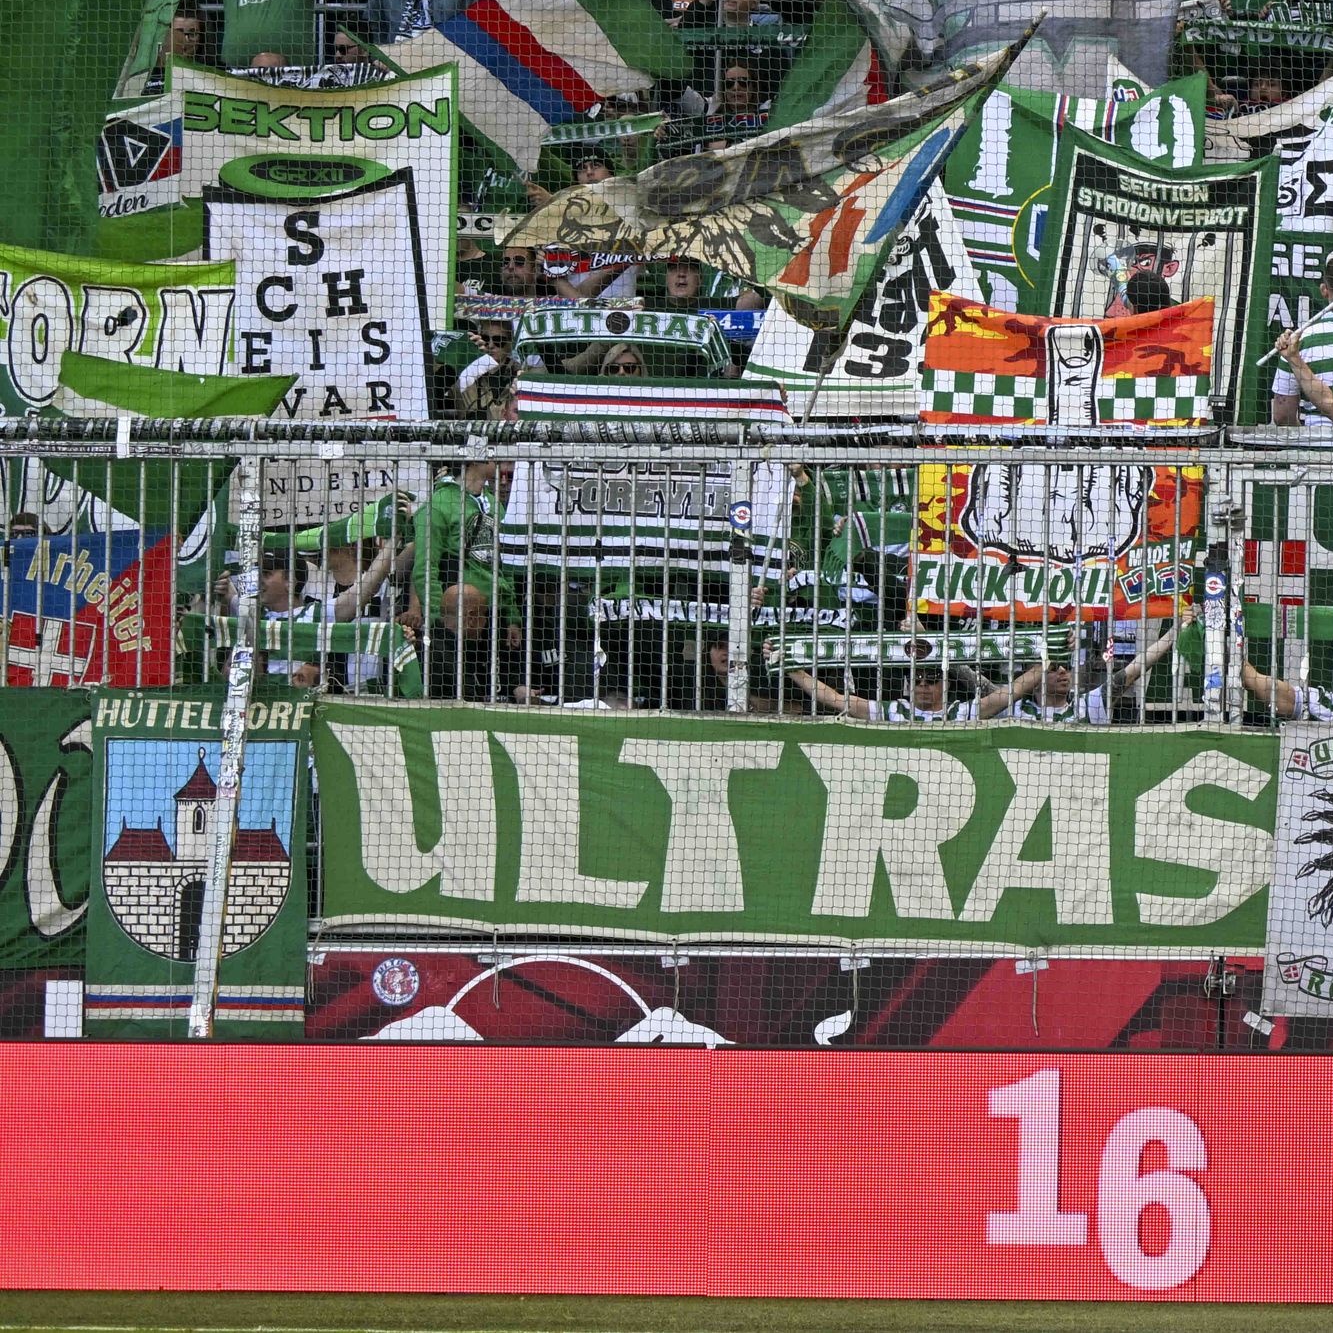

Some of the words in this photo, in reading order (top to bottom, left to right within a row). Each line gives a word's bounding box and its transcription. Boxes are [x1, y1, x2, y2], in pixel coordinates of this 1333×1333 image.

[1186, 26, 1275, 45] RAPID
[183, 91, 452, 142] SEKTION
[1077, 186, 1250, 228] STADIONVERBOT
[914, 560, 1005, 604] FUCK
[96, 693, 312, 732] HÜTTELORF
[328, 721, 1274, 927] ULTRAS
[986, 1067, 1212, 1291] 16
